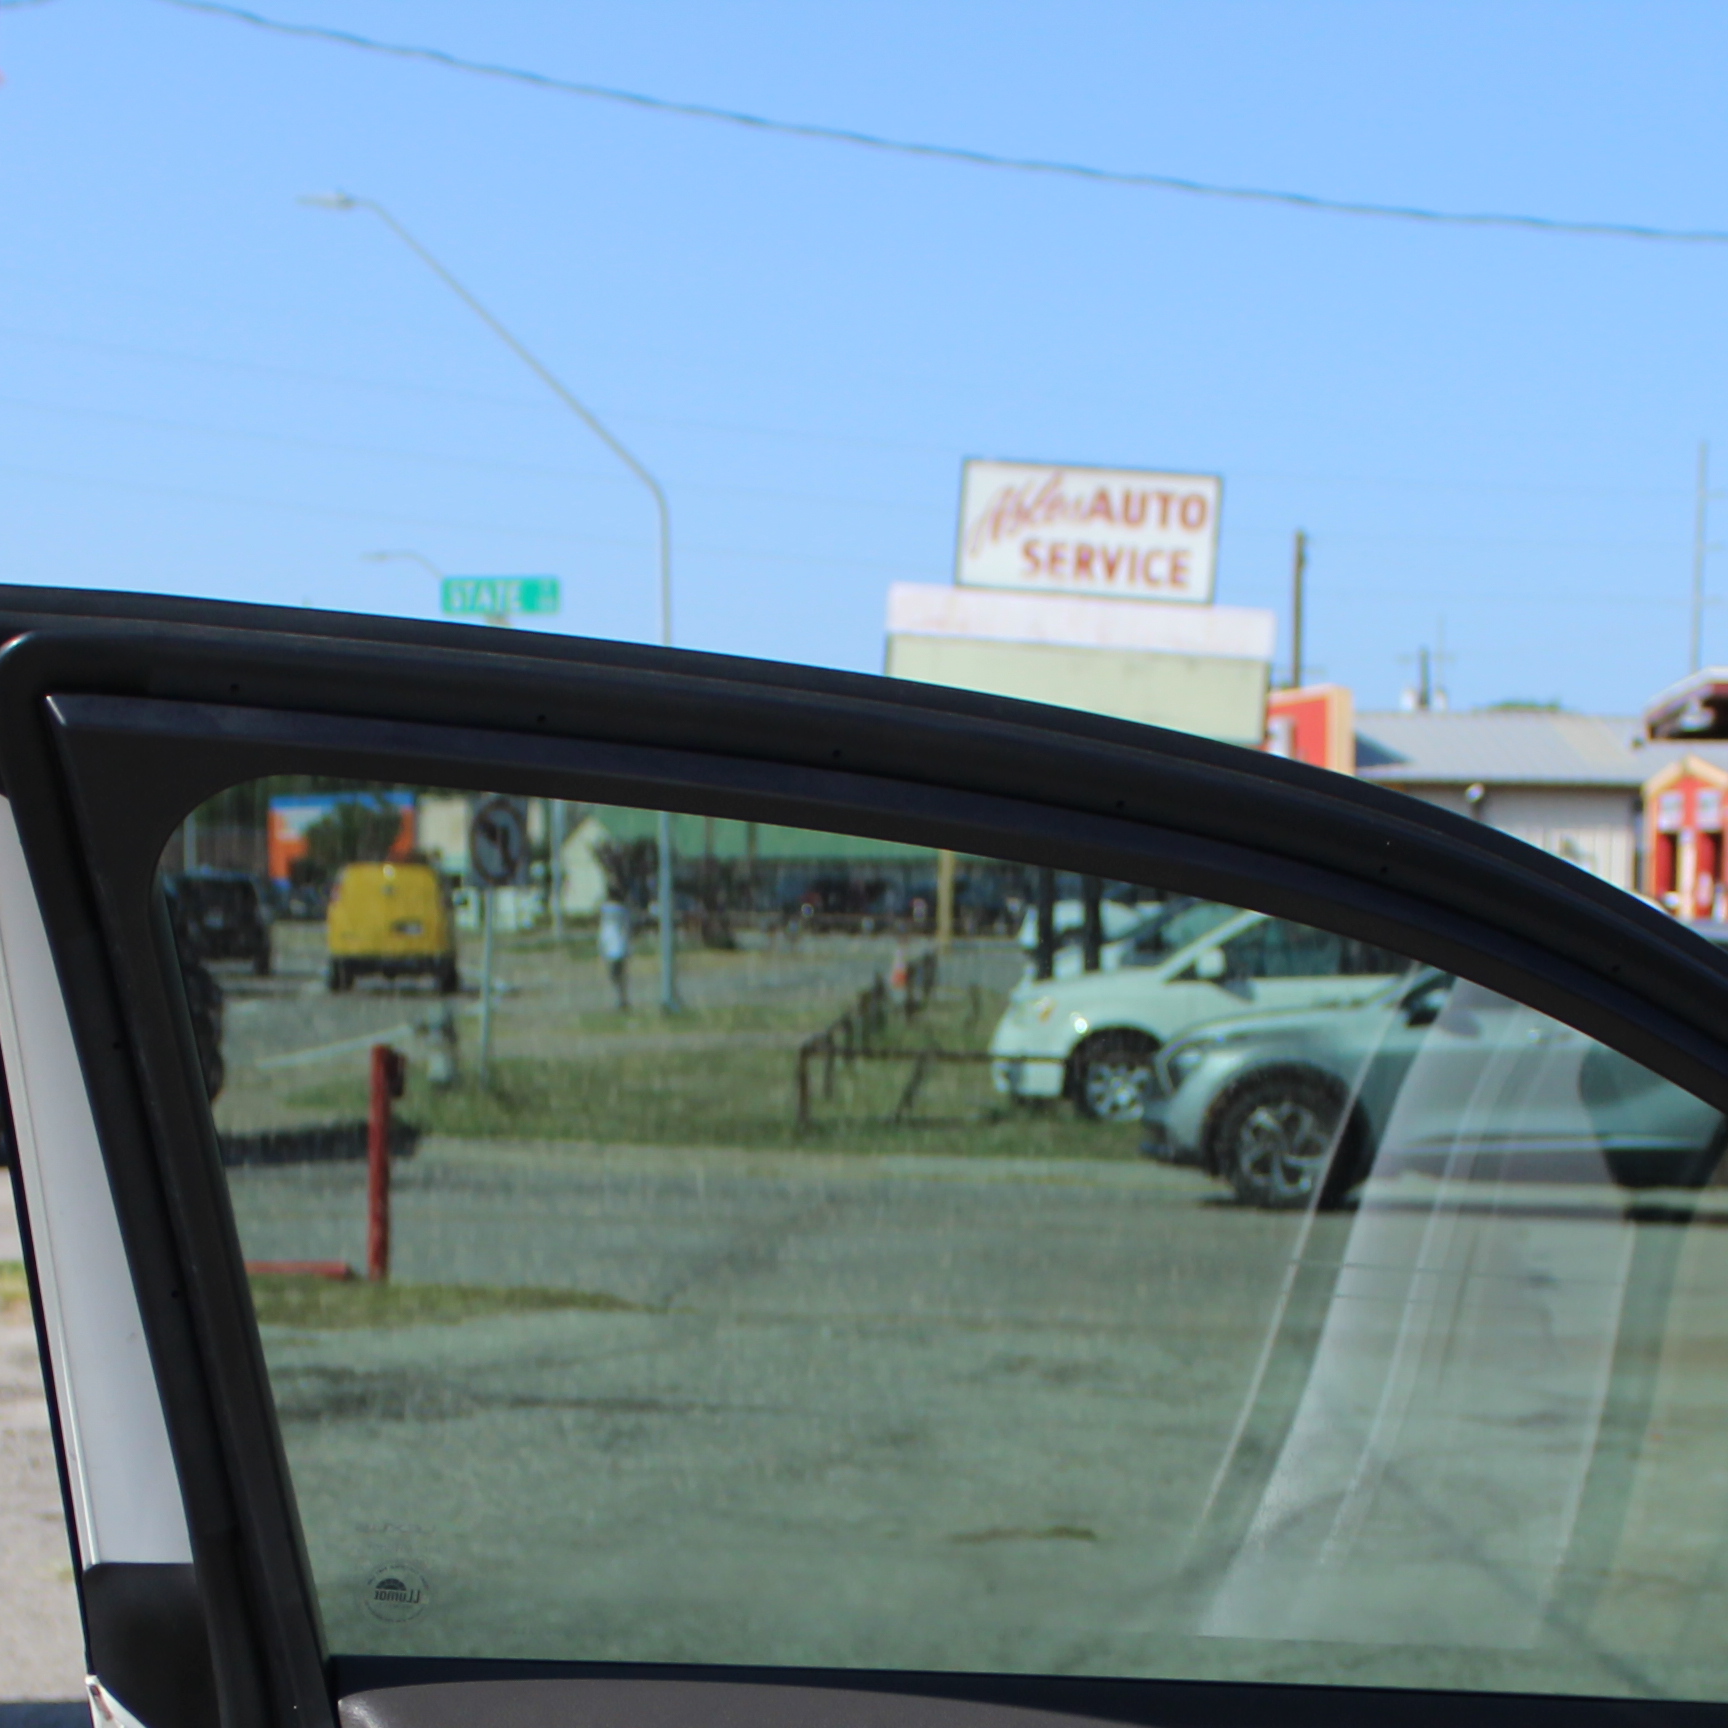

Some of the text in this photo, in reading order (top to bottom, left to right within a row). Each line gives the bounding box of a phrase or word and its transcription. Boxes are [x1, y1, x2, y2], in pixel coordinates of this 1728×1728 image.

[1087, 486, 1209, 534] AUTO
[1021, 538, 1193, 590] SERVICE
[448, 580, 522, 612] STATE
